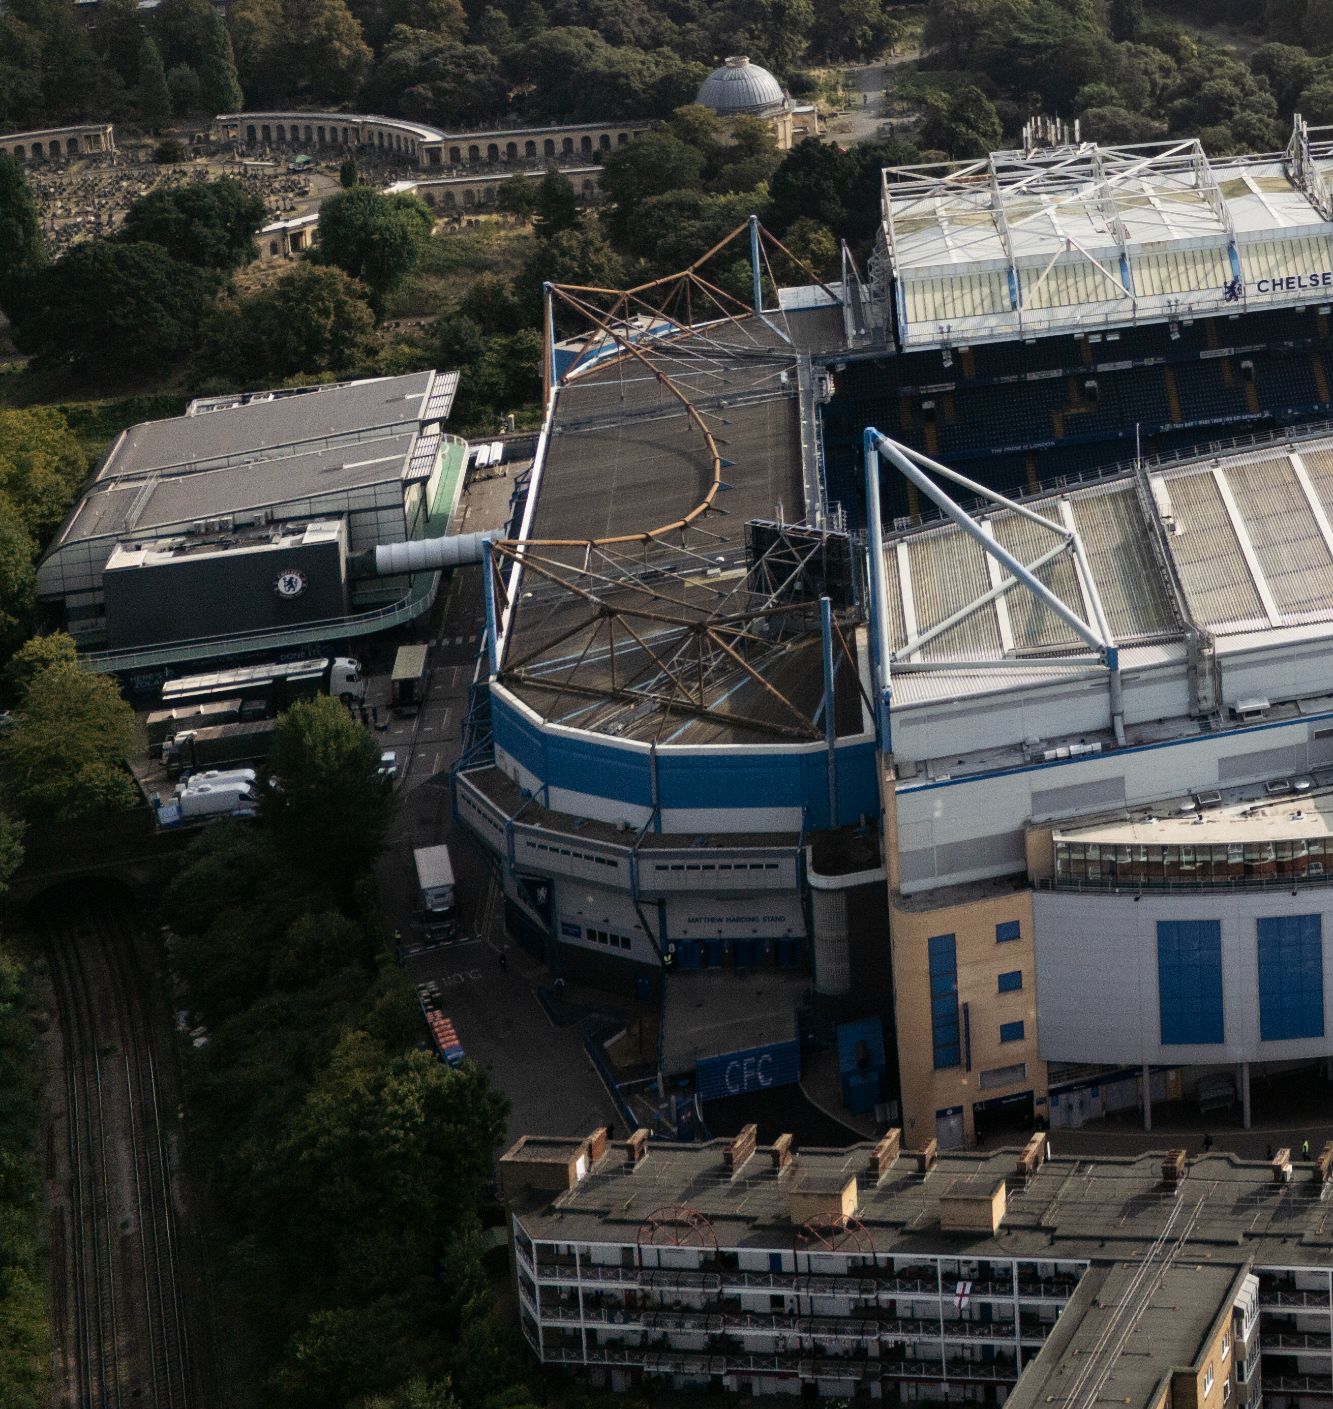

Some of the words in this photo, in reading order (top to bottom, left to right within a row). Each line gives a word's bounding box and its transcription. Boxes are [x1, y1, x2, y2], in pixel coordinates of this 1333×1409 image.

[687, 916, 724, 924] MATTHEW
[726, 915, 760, 924] HARDING
[762, 915, 786, 923] STAND
[725, 1054, 773, 1093] CFC
